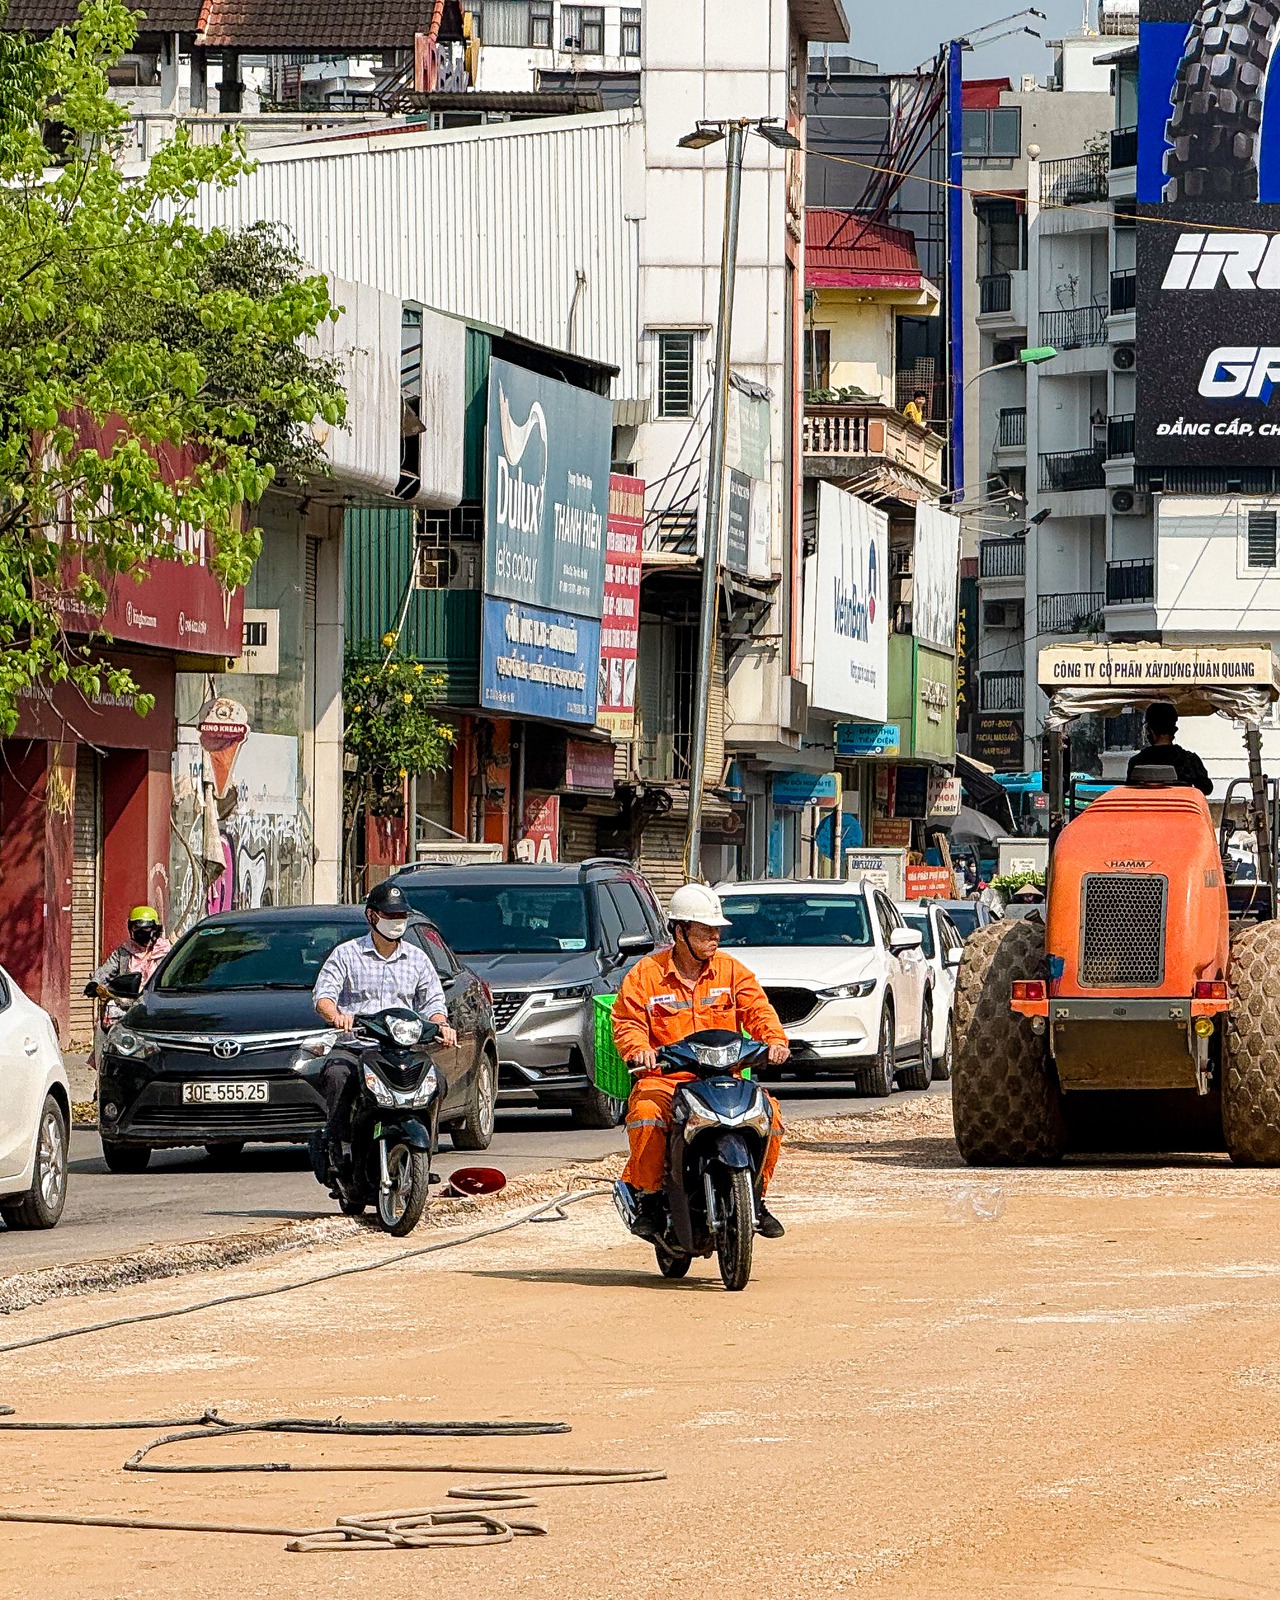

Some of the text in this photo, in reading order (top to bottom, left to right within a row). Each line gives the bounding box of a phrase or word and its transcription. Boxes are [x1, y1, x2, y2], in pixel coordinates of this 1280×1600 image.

[1156, 416, 1211, 436] ĐẲNG
[1213, 418, 1255, 439] CẤP,
[497, 456, 546, 534] Dulux
[1053, 660, 1081, 678] CÔNG
[1084, 663, 1095, 677] TY
[1192, 660, 1220, 678] XUÂN
[1221, 662, 1255, 678] QUANG
[219, 725, 244, 733] KREAM
[184, 1083, 268, 1102] 30E-555.25
